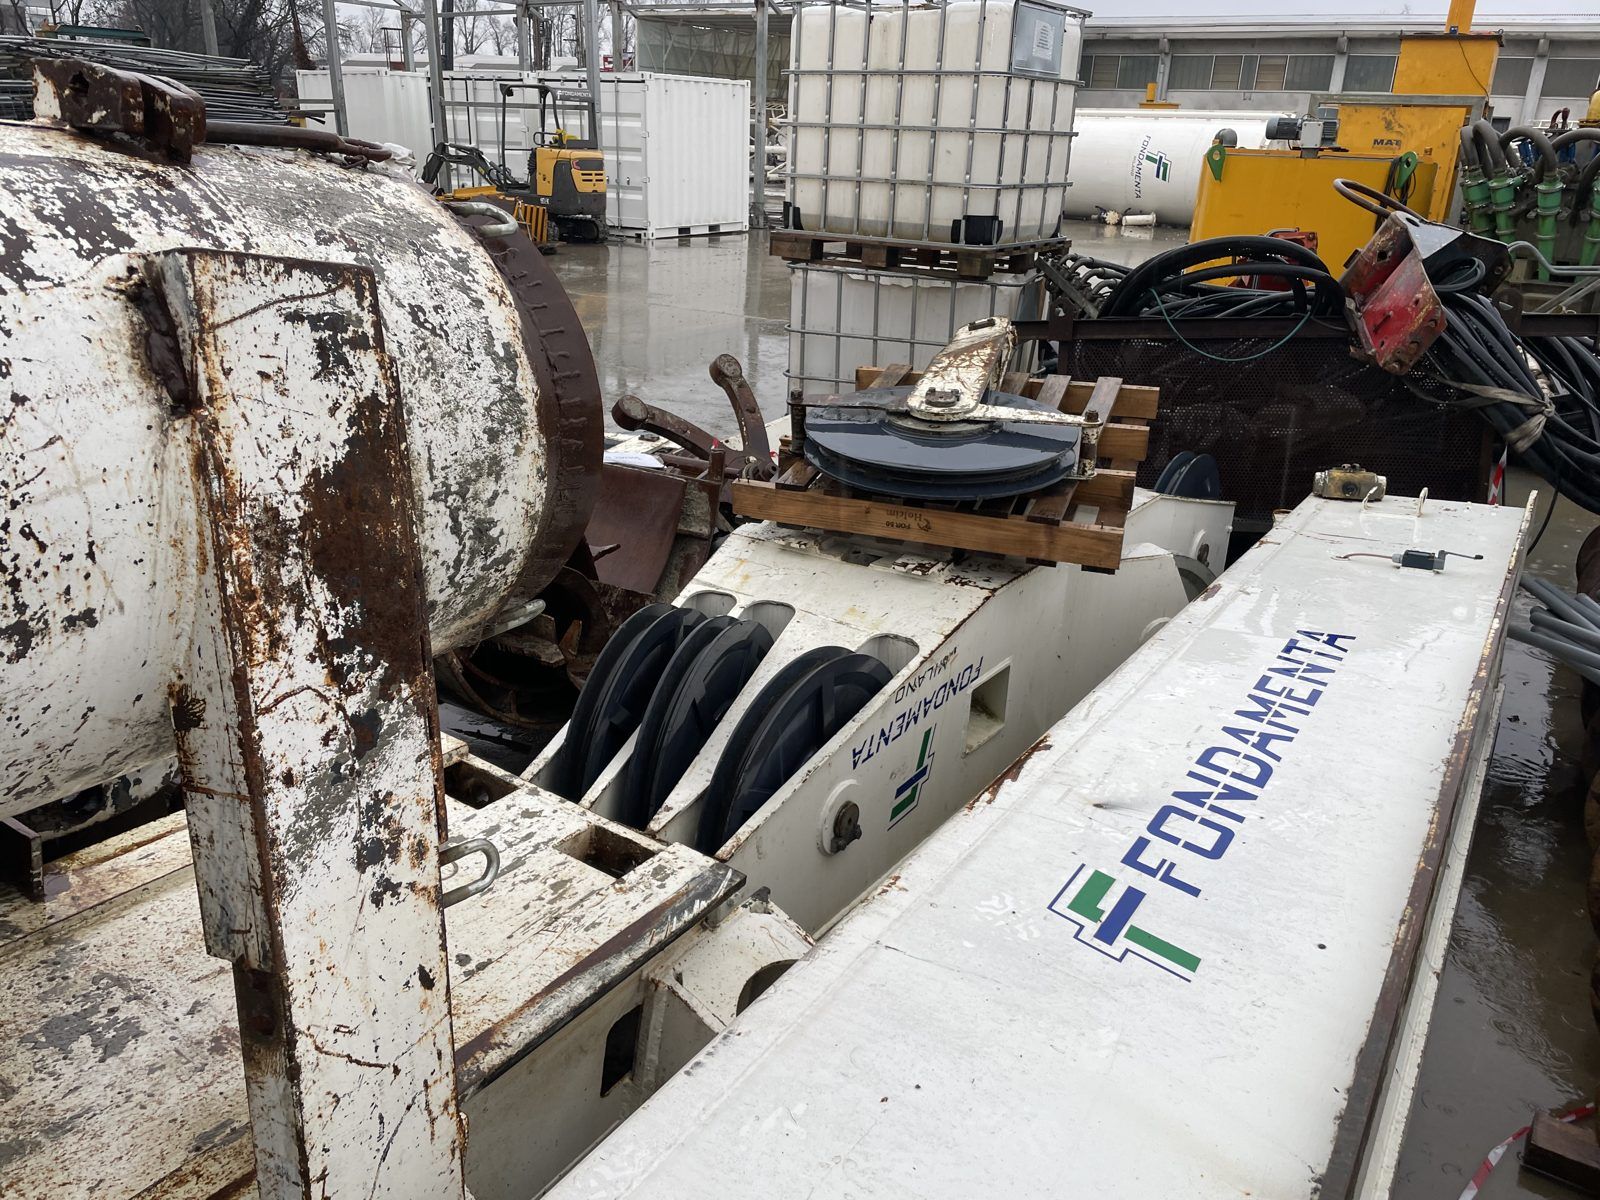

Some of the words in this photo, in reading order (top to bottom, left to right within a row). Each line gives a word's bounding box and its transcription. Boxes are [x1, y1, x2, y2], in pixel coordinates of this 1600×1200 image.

[1134, 135, 1152, 199] FONDAMENTA
[851, 656, 984, 770] FONDAMENTA
[1121, 629, 1357, 897] FONDAMENTA
